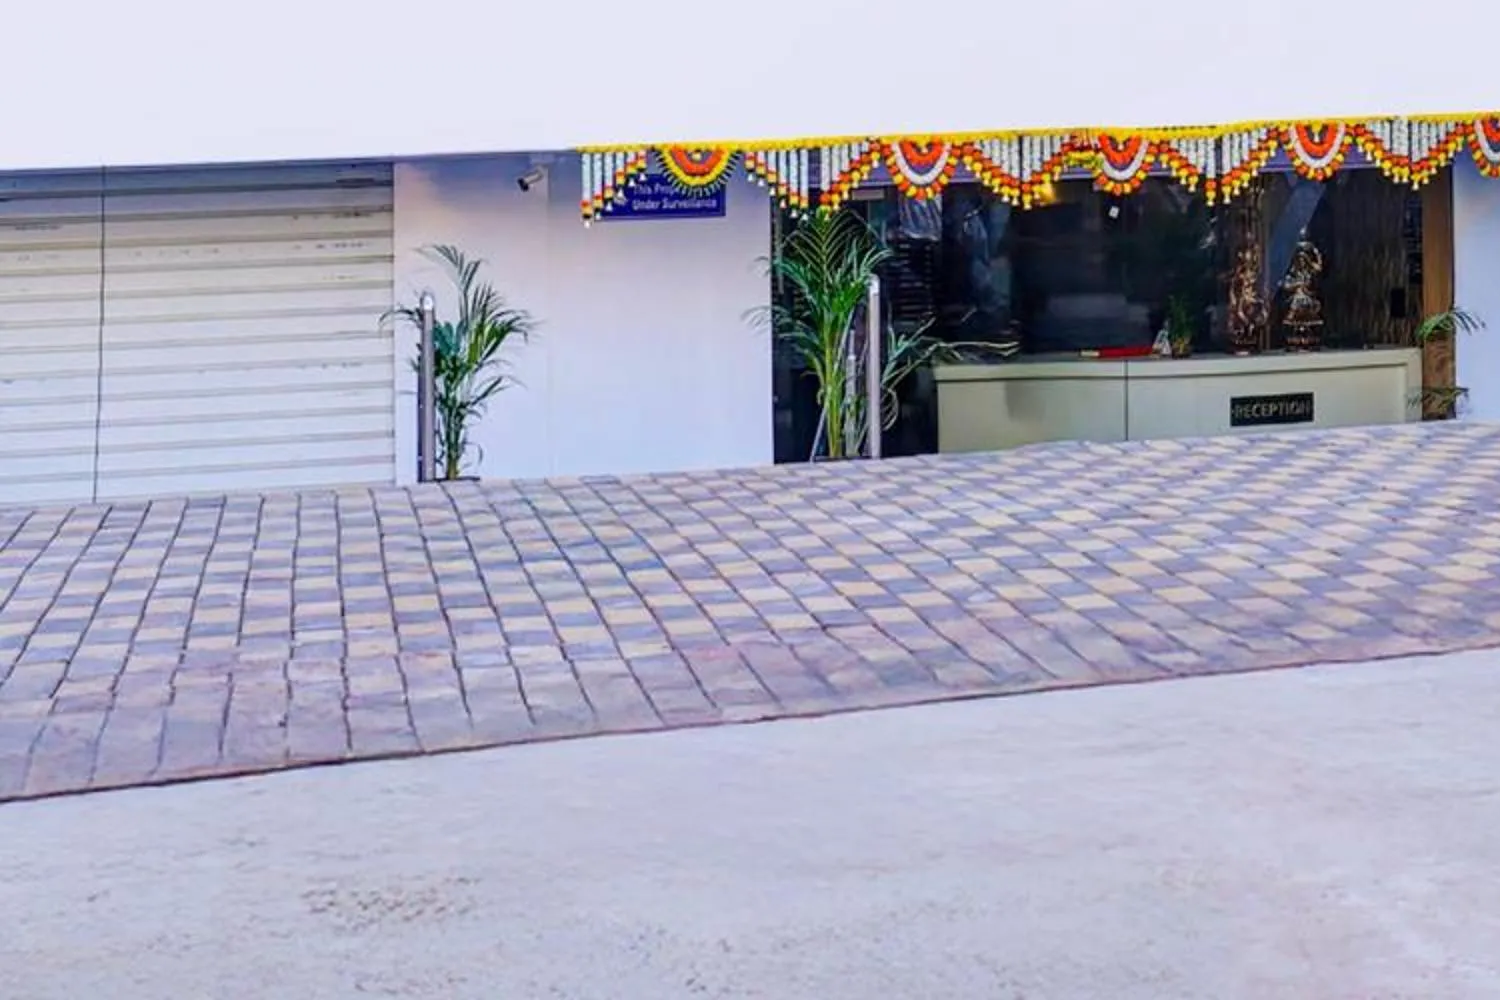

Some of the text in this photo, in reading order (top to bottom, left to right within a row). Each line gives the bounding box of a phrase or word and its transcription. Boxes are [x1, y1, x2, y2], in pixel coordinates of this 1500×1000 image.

[632, 197, 717, 210] Under Surveillance
[1232, 399, 1312, 419] RECEPTION
